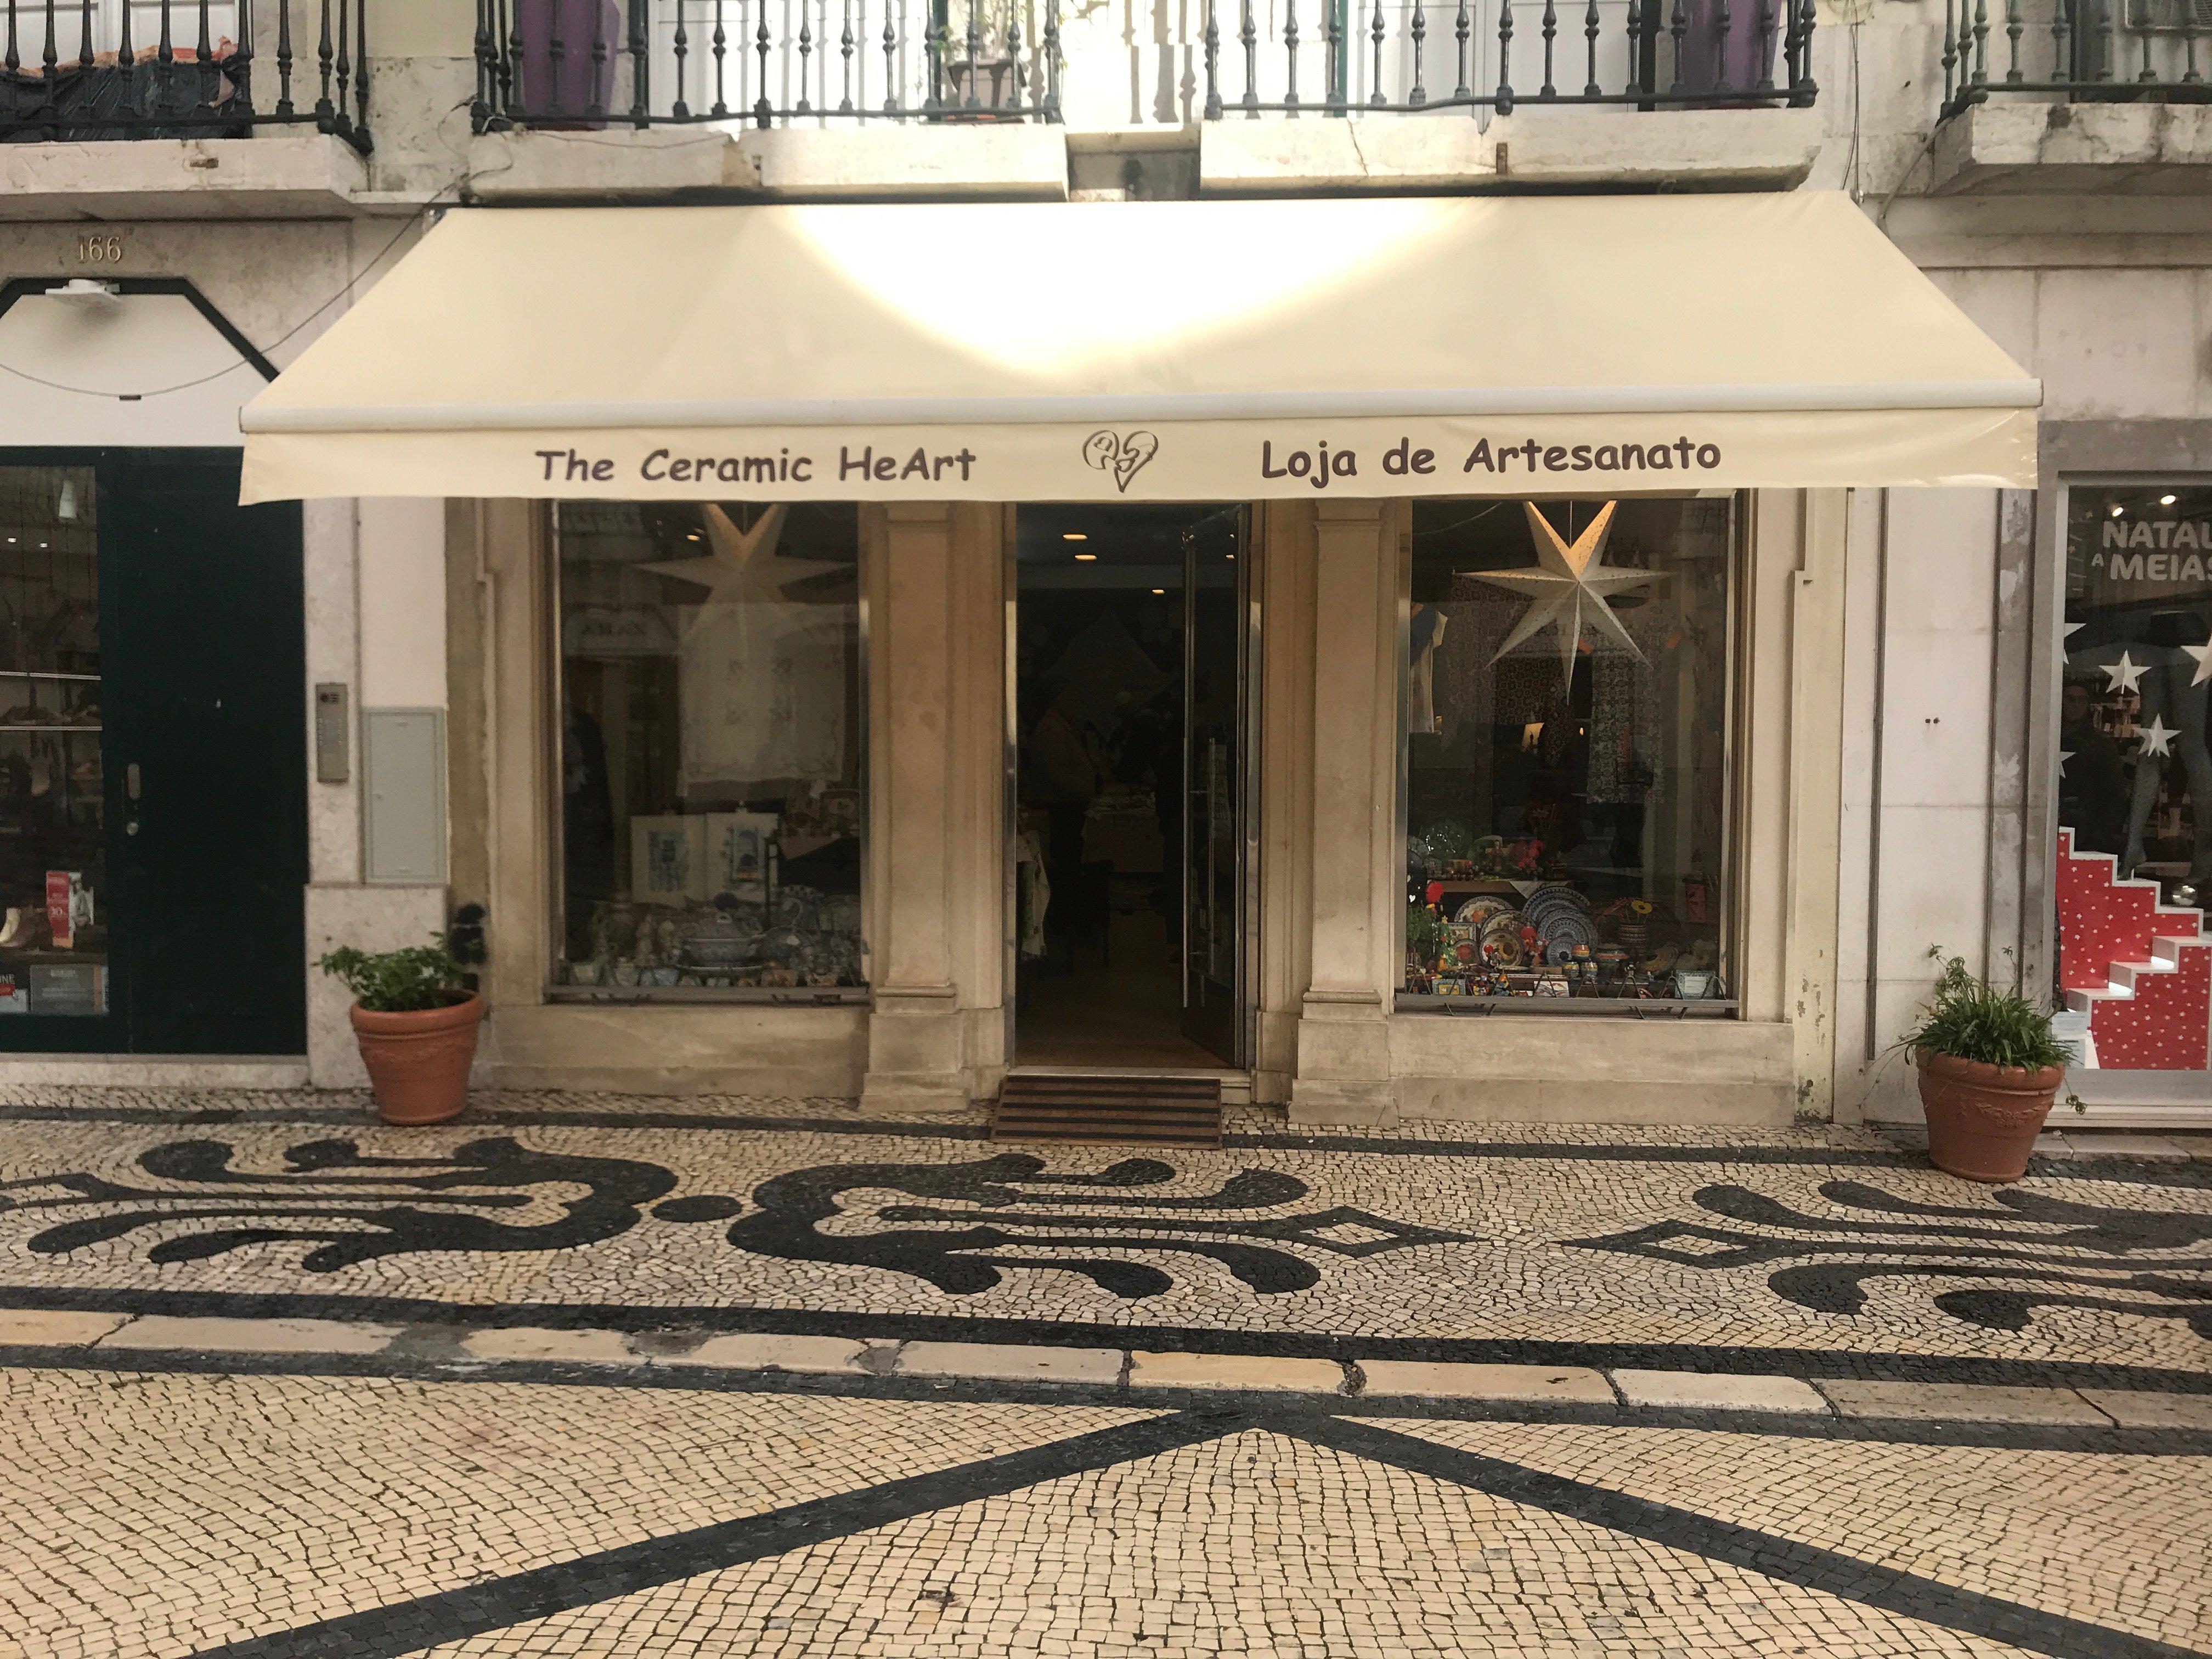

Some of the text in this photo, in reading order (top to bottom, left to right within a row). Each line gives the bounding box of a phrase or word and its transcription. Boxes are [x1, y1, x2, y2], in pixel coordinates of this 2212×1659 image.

[78, 236, 121, 262] 166
[535, 445, 977, 483] The Ceramic HeArt
[1262, 436, 1722, 489] Loja de Artesanato
[2110, 554, 2212, 580] MEIA
